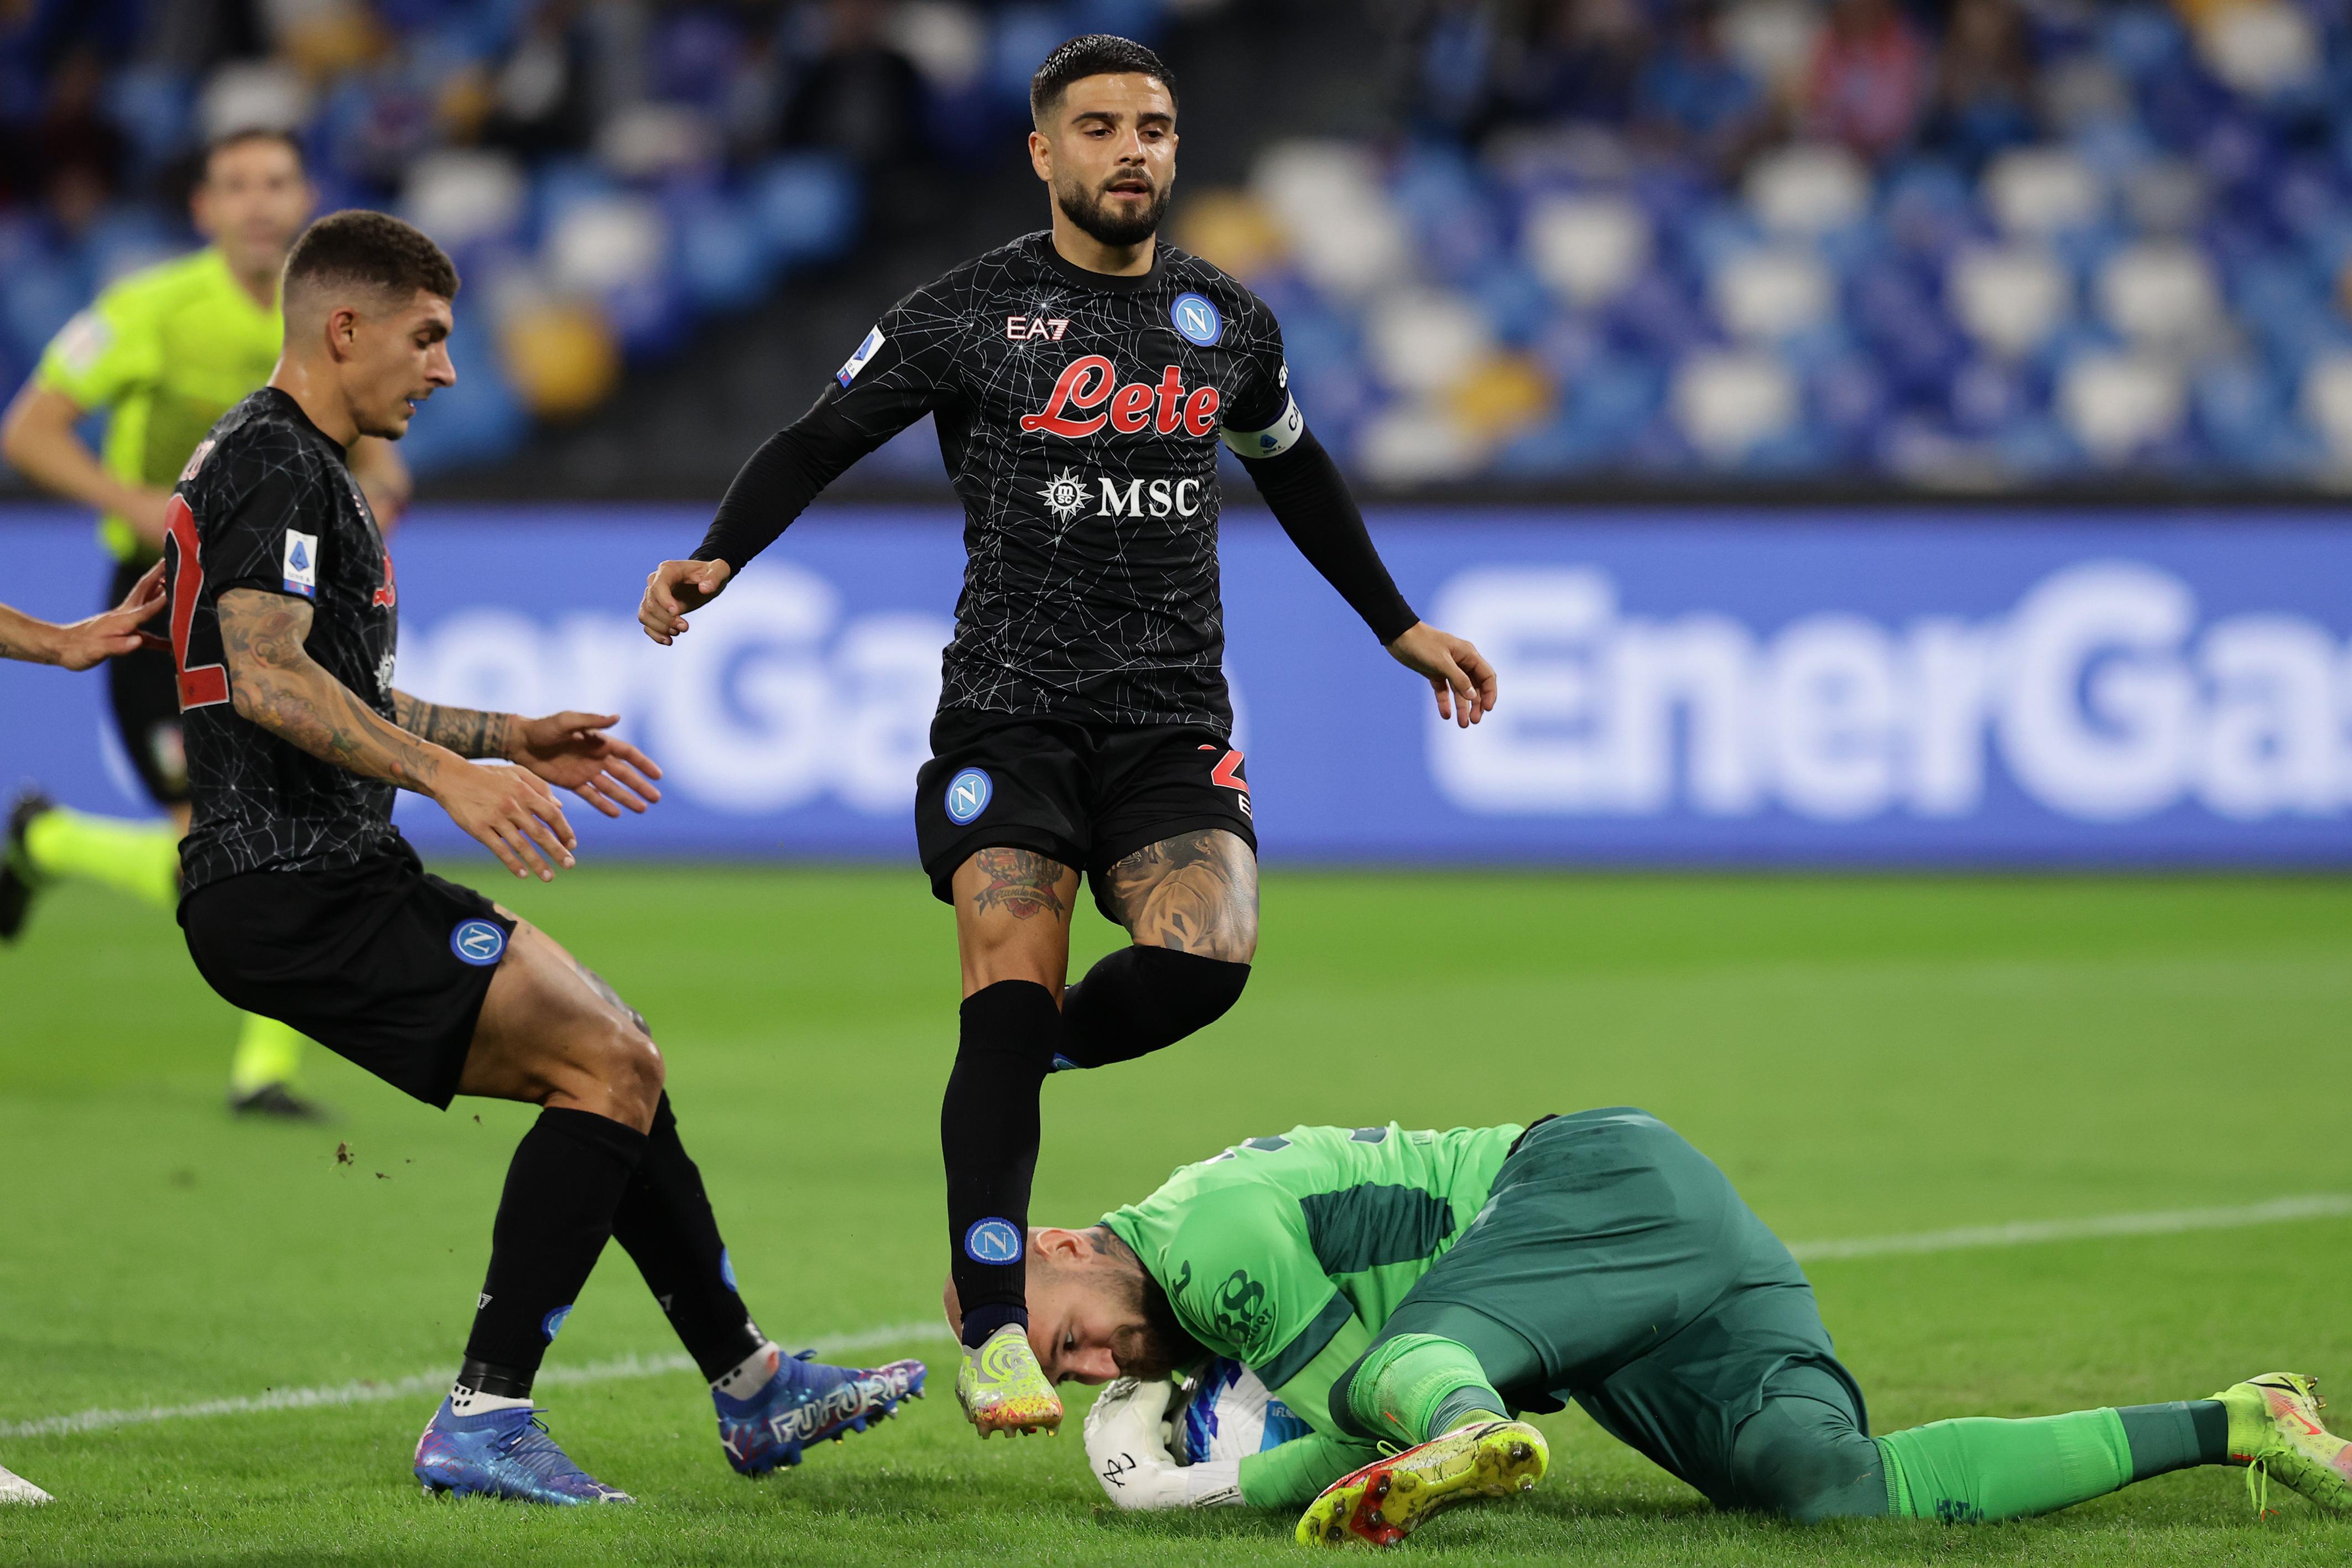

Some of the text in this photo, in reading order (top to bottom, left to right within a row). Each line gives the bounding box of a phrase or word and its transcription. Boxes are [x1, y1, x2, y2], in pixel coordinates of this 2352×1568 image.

[1006, 316, 1069, 341] EA7
[1020, 354, 1220, 439] Lete
[1096, 477, 1200, 517] MSC
[1430, 559, 2352, 820] EnerGa
